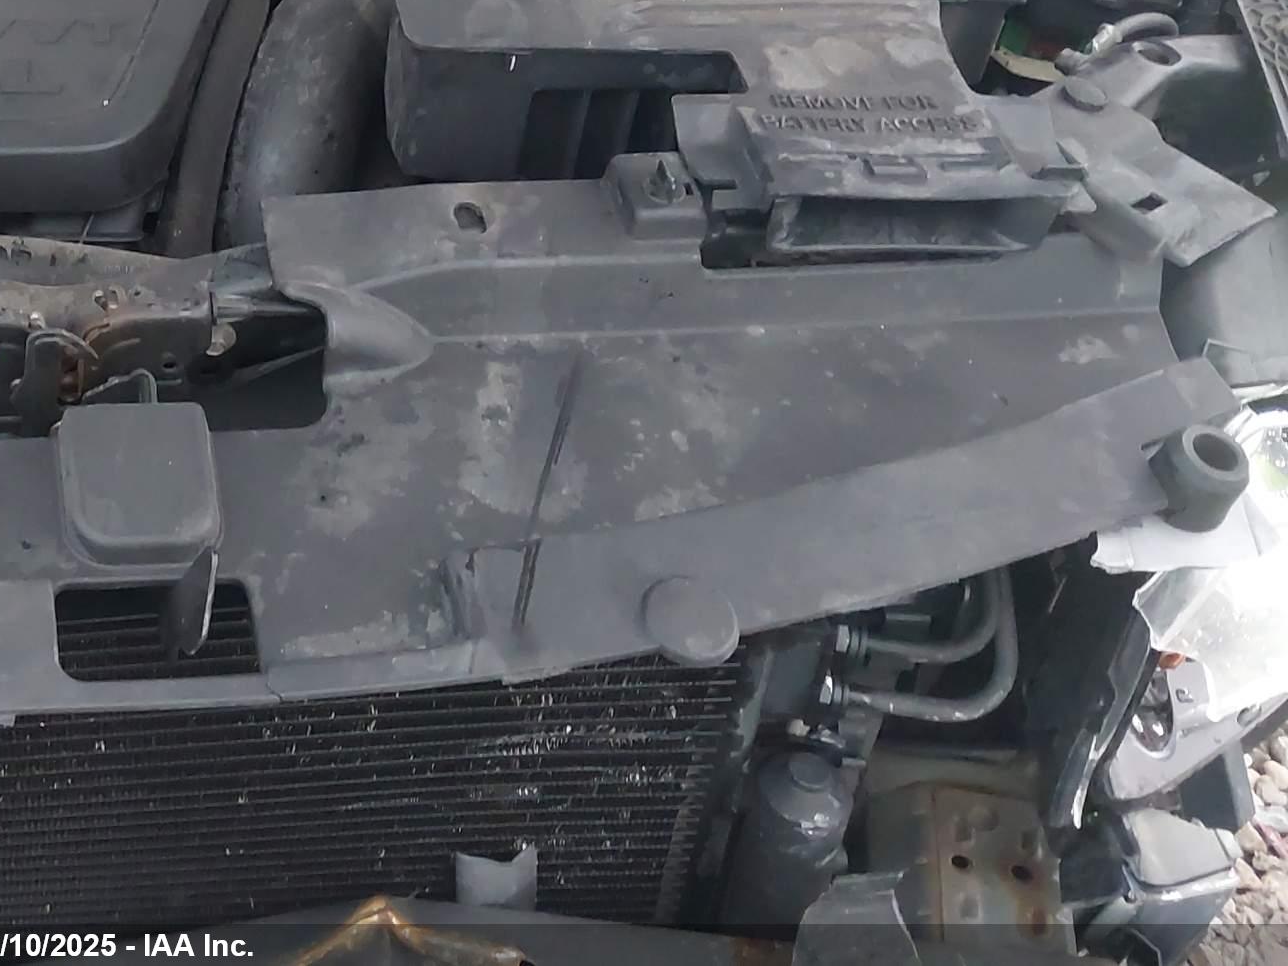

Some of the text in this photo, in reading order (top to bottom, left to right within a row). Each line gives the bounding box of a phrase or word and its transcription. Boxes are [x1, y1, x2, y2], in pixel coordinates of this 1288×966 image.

[768, 94, 940, 112] REMOVE FOR
[759, 113, 981, 134] BATTERY ACCESS
